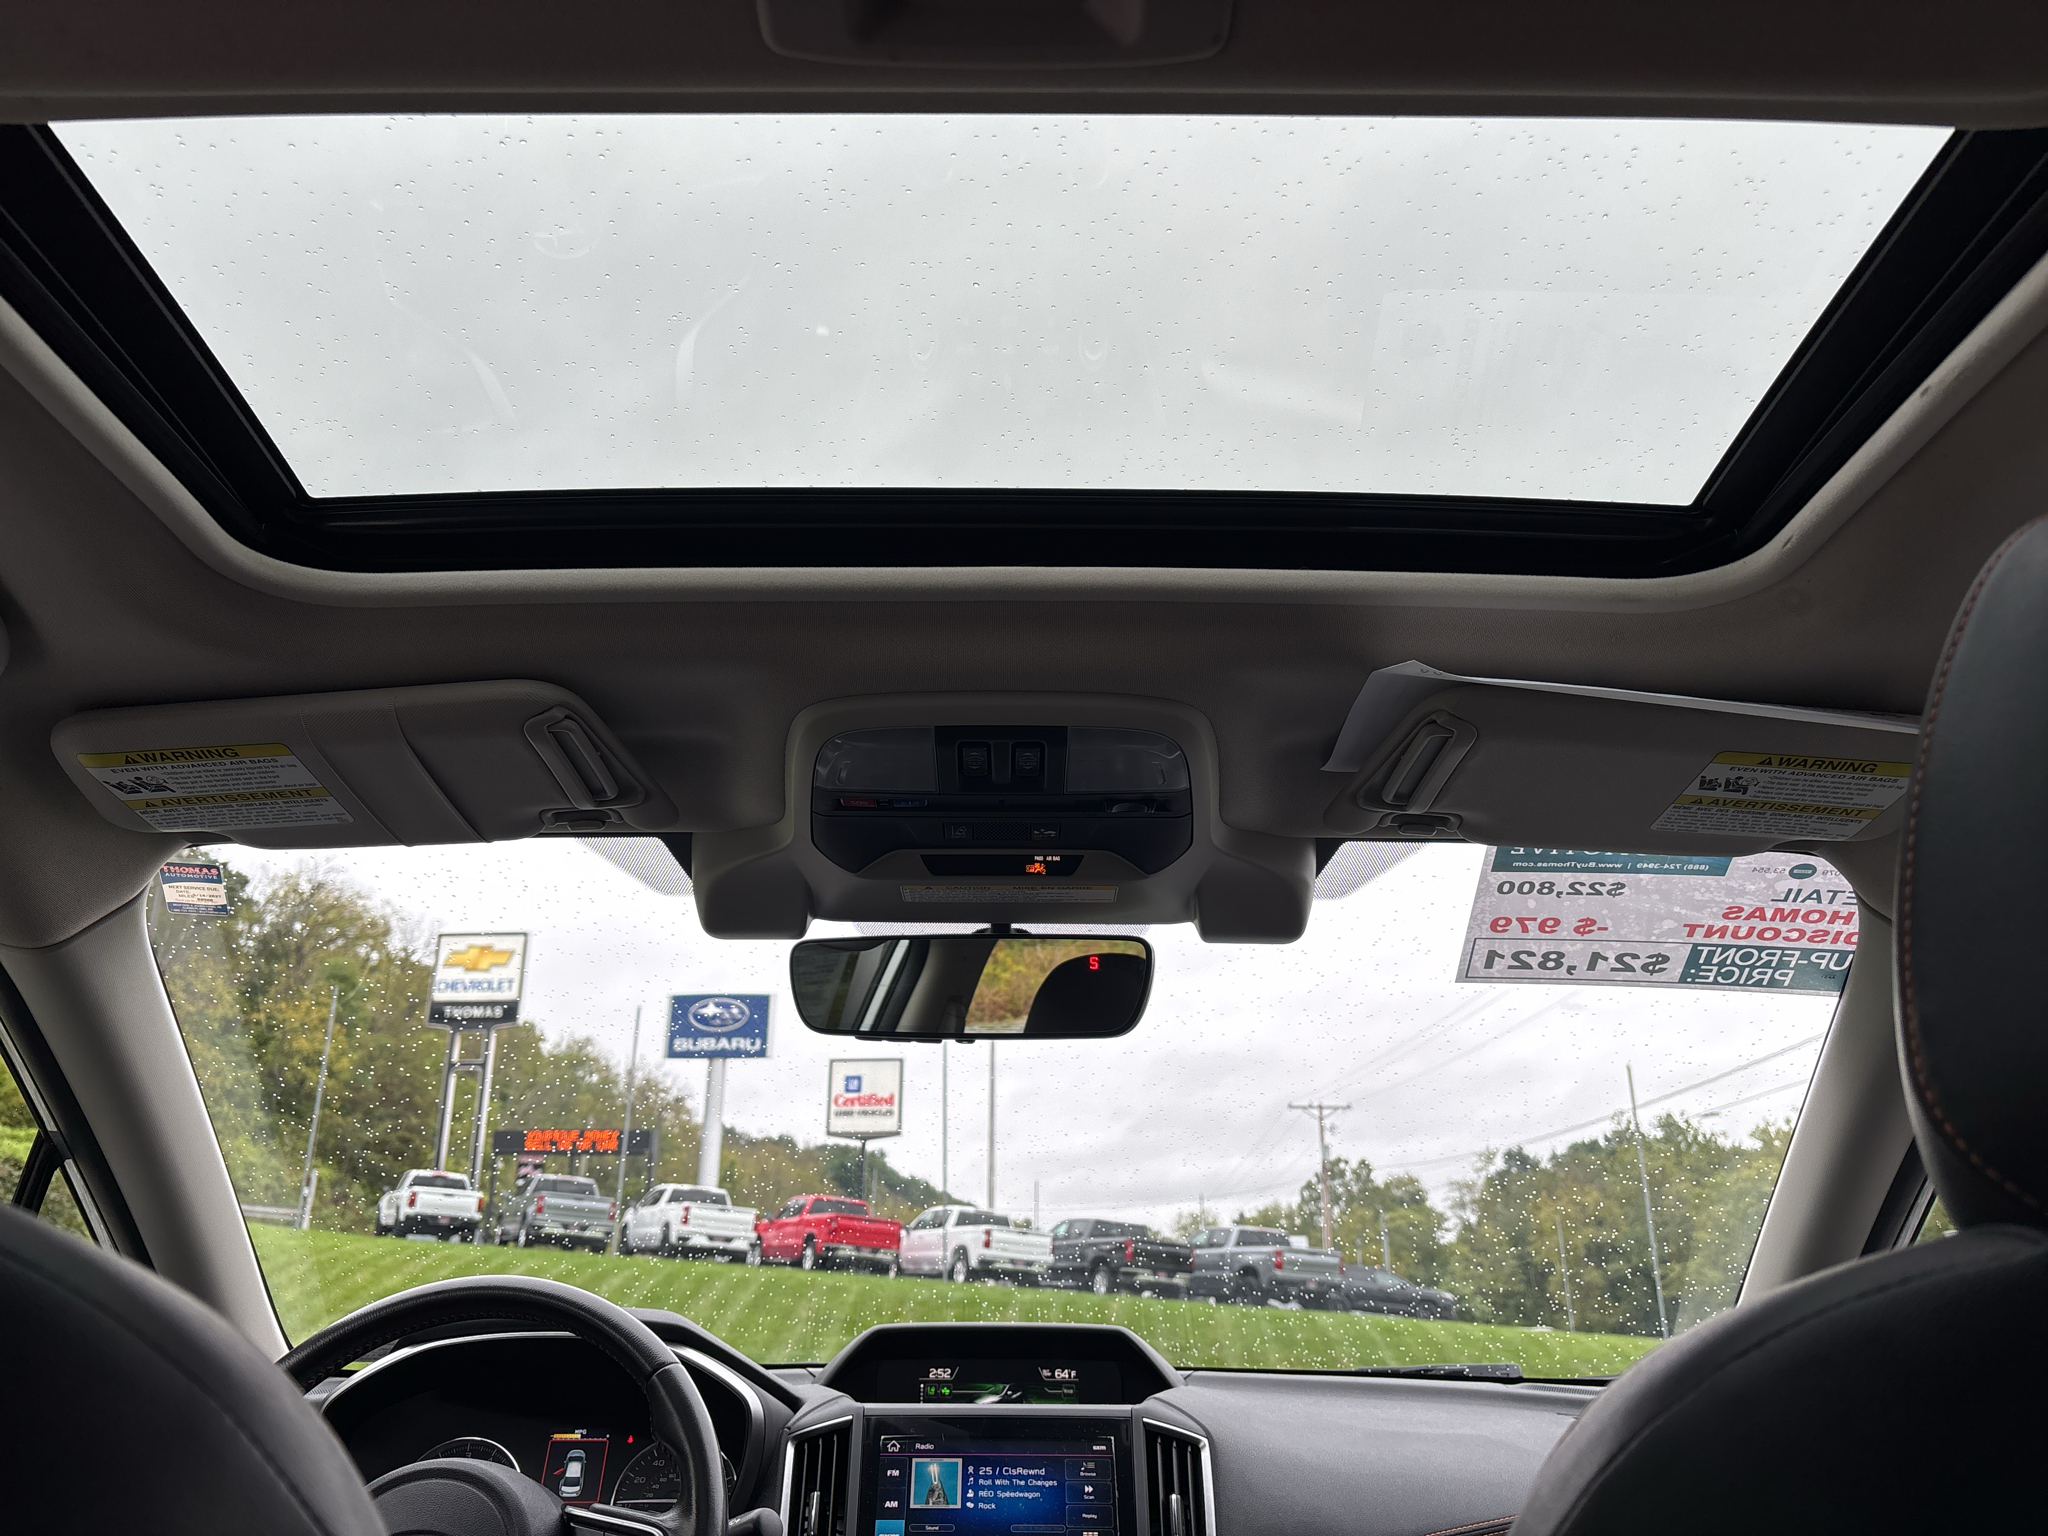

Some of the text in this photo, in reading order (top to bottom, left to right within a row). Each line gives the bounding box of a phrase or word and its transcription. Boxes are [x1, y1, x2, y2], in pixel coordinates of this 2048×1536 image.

[136, 748, 240, 763] WARNING
[171, 760, 227, 770] ADVANCED
[230, 759, 247, 767] AIR
[249, 757, 279, 765] BAGS
[1778, 757, 1879, 773] WARNING
[1787, 771, 1846, 779] ADVANCED
[1868, 776, 1899, 784] BAGS
[161, 789, 312, 807] AVERTISSEMENT
[1708, 799, 1867, 817] AVERTISSEMENT
[162, 865, 219, 876] THOMAS
[165, 872, 218, 880] AUTOMOTIVE
[1090, 956, 1099, 970] S
[435, 978, 515, 993] CHEVROLET
[442, 1004, 504, 1019] THOMAS
[673, 1036, 762, 1053] SUBARU
[915, 1443, 935, 1451] Radio
[652, 1459, 666, 1467] 40
[886, 1469, 900, 1477] FM
[978, 1467, 993, 1476] 25
[1002, 1467, 1046, 1476] ClsRewnd
[633, 1476, 647, 1484] 20
[1027, 1479, 1058, 1488] Changes
[978, 1490, 1042, 1500] REO Speedwagon
[884, 1500, 899, 1509] AM
[978, 1502, 997, 1510] Rock
